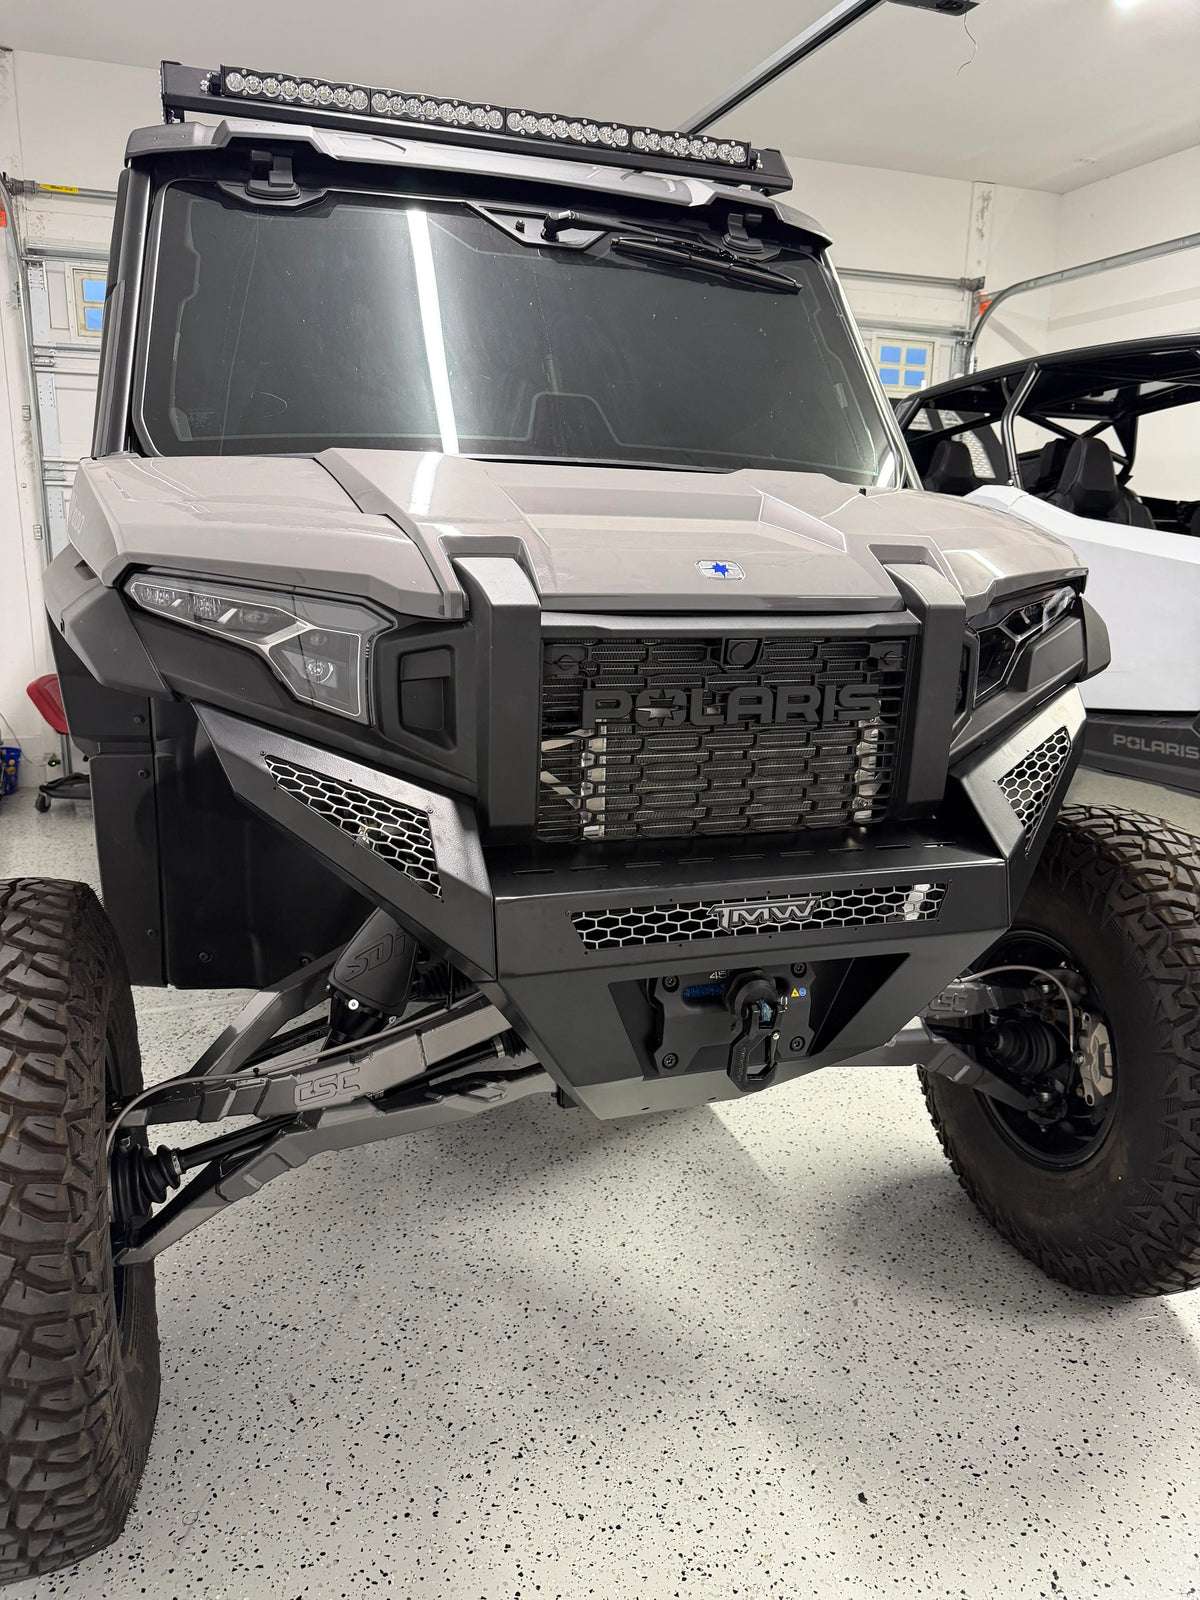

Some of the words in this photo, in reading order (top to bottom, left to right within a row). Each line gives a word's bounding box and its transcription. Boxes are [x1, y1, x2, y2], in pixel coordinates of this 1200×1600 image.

[582, 685, 880, 729] POLARIS
[1113, 734, 1199, 759] POLARIS
[706, 896, 821, 934] TMW
[709, 970, 729, 980] 45
